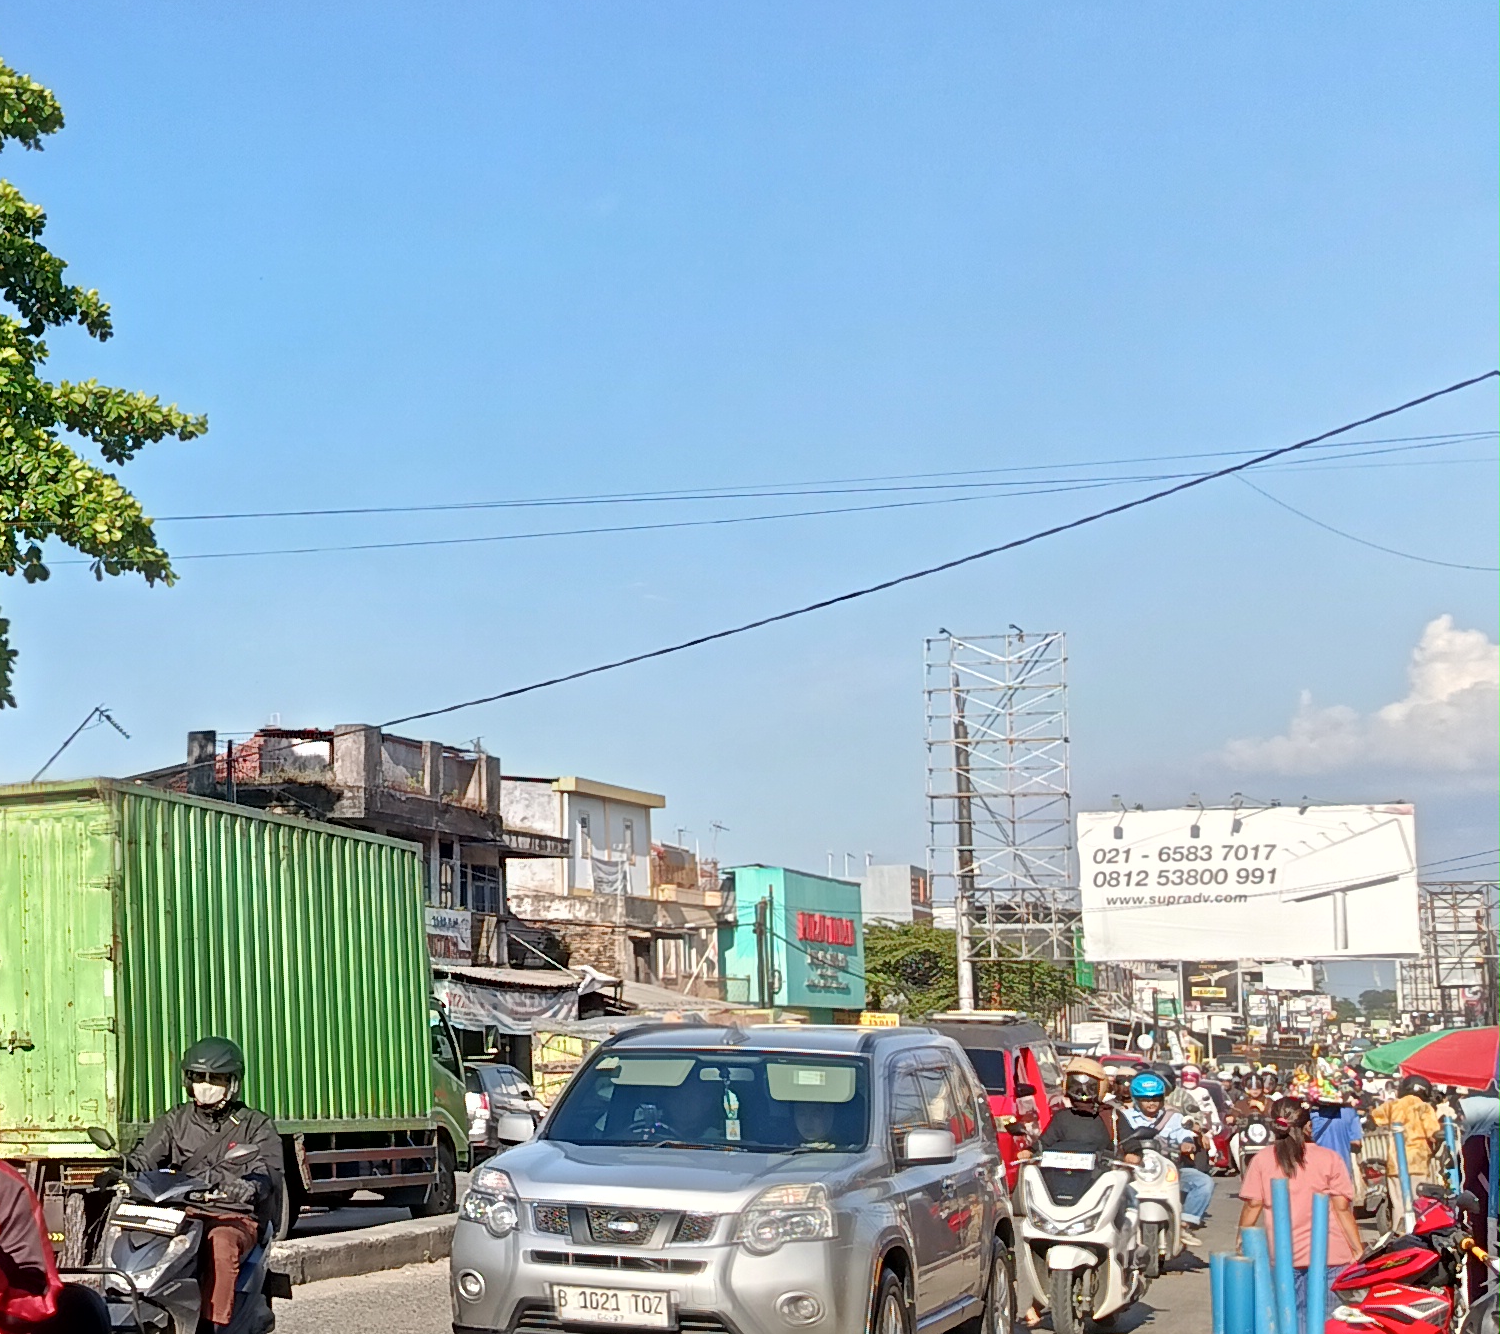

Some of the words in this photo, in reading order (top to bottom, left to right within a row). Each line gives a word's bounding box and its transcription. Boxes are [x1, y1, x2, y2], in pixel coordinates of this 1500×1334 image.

[1092, 848, 1131, 865] 021
[1158, 845, 1214, 863] 6583
[1222, 844, 1278, 861] 7017
[1092, 870, 1149, 888] 0812
[1156, 868, 1229, 886] 53800
[1236, 867, 1278, 885] 991
[1105, 892, 1248, 906] www.supradv.com
[558, 1289, 568, 1308] B
[631, 1293, 663, 1315] TOZ
